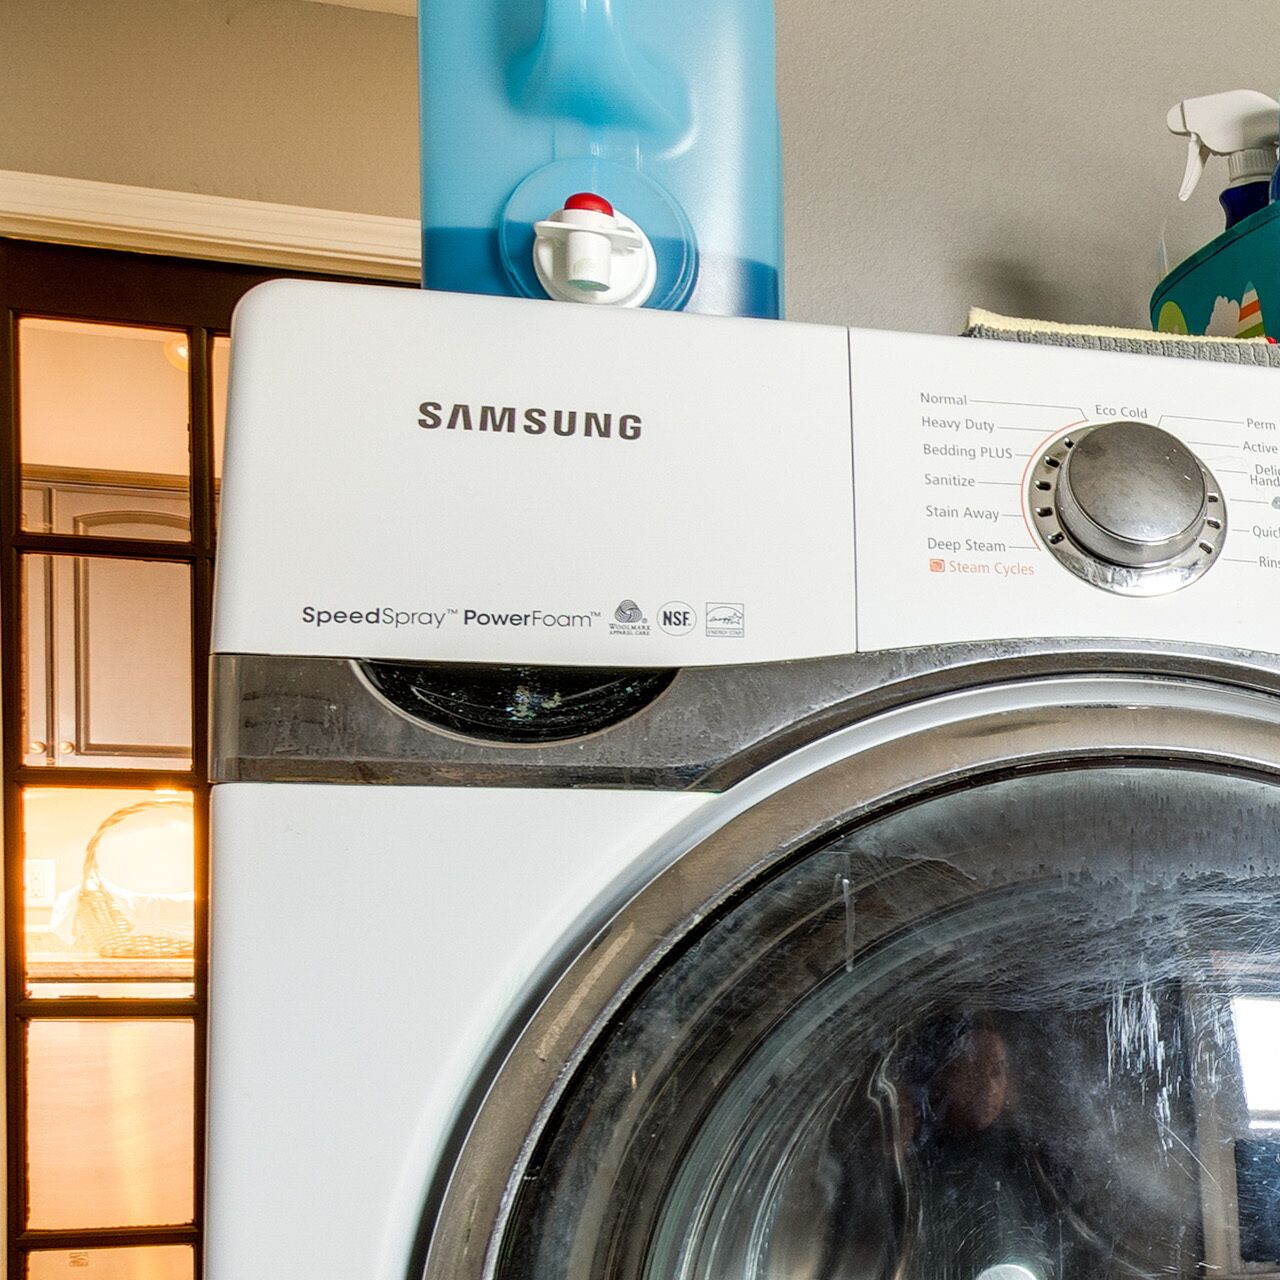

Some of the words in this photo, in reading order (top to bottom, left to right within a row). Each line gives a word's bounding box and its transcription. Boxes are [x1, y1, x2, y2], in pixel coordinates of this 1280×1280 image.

[920, 392, 968, 406] Normal
[1095, 404, 1117, 416] Eco
[1120, 406, 1148, 419] Cold
[417, 401, 643, 441] SAMSUNG
[921, 416, 961, 431] Heavy
[965, 418, 995, 433] Duty
[1246, 417, 1276, 431] Perm
[923, 444, 977, 460] Bedding
[980, 447, 1013, 460] PLUS
[1242, 441, 1279, 454] Active
[924, 473, 976, 487] Sanitize
[1250, 475, 1280, 488] Hand
[926, 505, 959, 518] Stain
[963, 507, 1000, 522] Away
[927, 537, 961, 554] Deep
[965, 539, 1006, 552] Steam
[949, 560, 990, 574] Steam
[994, 562, 1035, 578] Cycles
[608, 624, 652, 632] WOOLMARK
